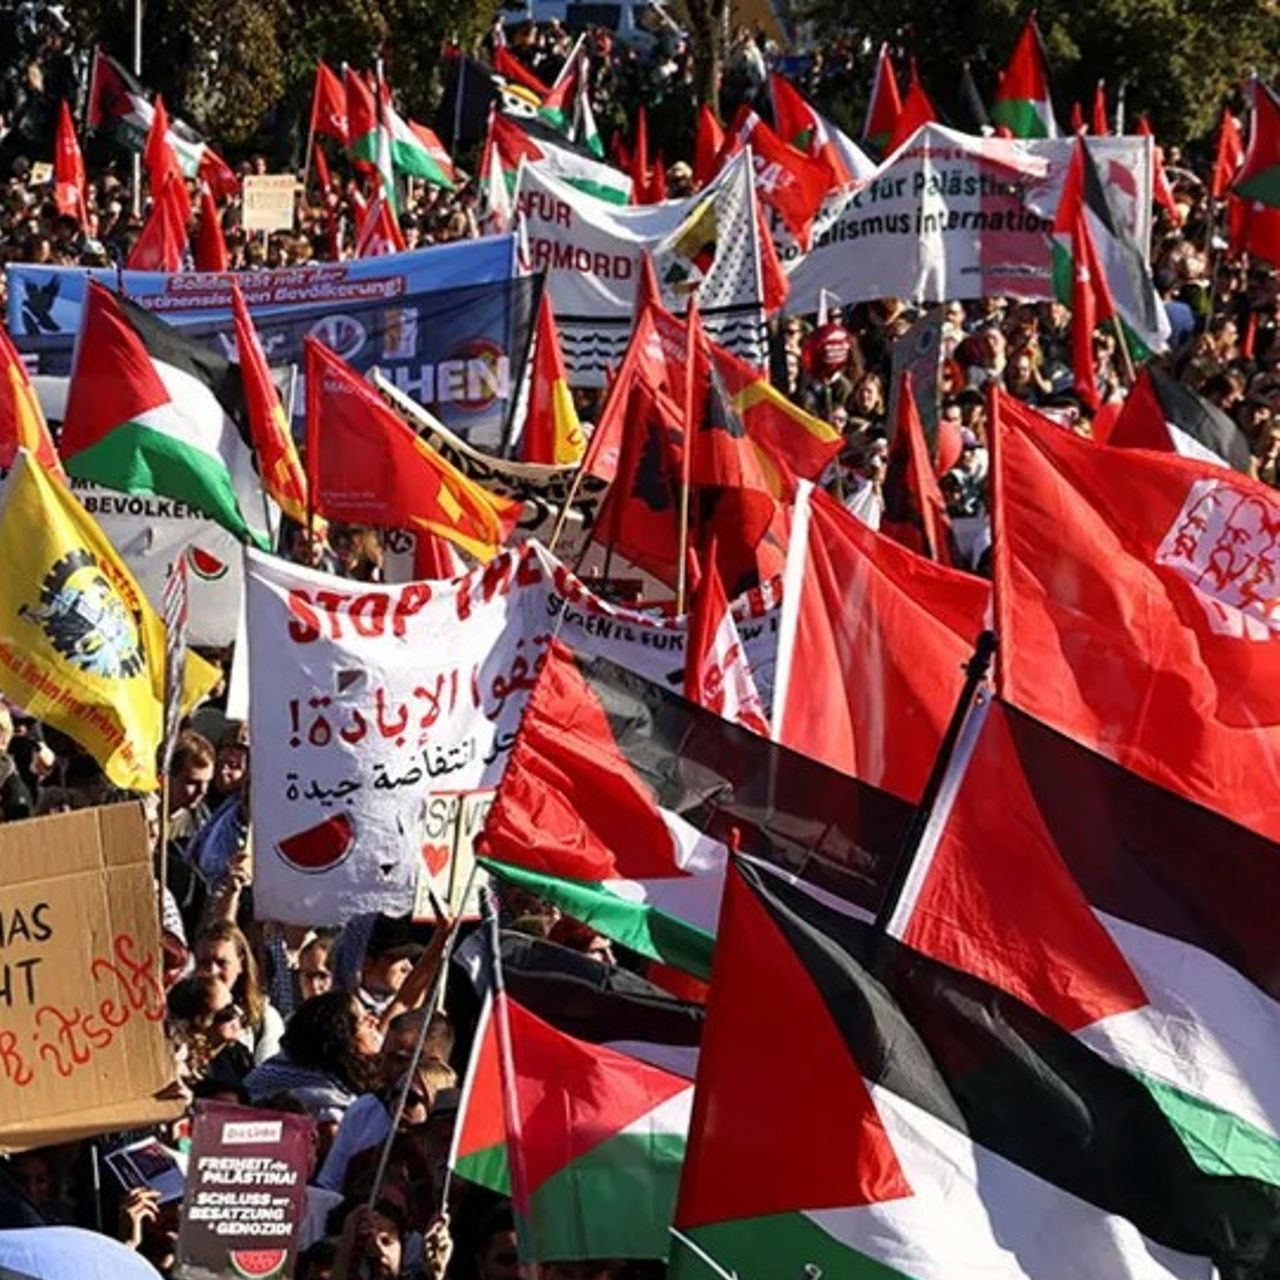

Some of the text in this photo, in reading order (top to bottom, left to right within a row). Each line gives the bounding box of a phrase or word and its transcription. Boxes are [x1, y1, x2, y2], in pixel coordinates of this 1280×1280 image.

[288, 581, 431, 644] STOP
[198, 1156, 273, 1171] FREIHEIT
[201, 1169, 298, 1185] PALÄSTINA!
[197, 1191, 271, 1206] SCHLUSS
[188, 1206, 285, 1220] BESATZUNG
